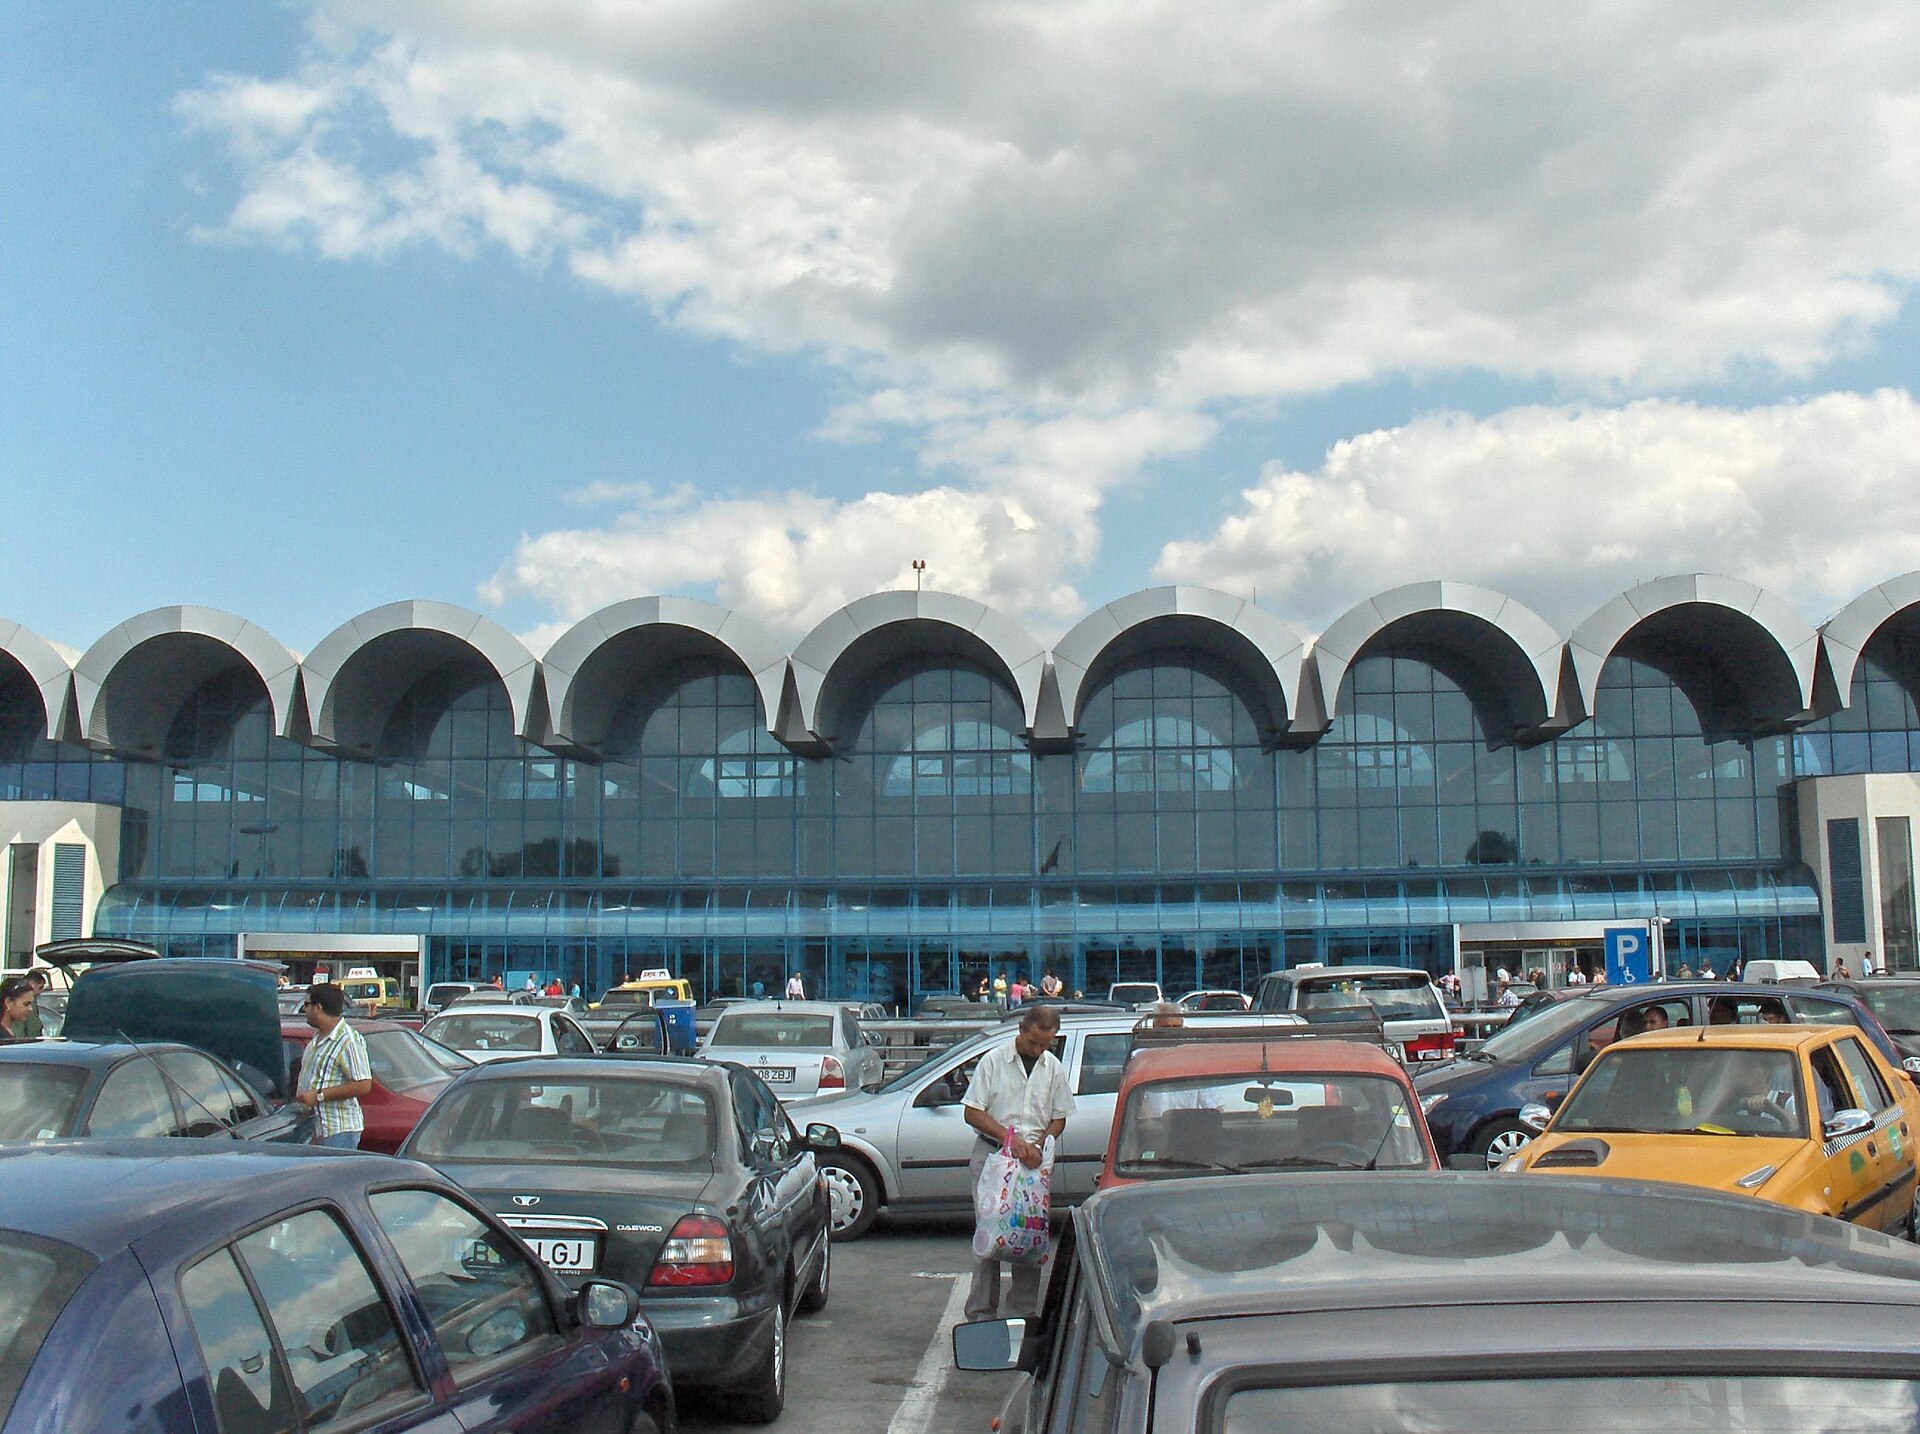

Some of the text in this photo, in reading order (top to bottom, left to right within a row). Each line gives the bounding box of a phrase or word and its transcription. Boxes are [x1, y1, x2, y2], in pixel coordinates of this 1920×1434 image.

[1616, 934, 1639, 968] P
[616, 1224, 663, 1232] DAEWOO
[537, 1241, 582, 1266] LGJ
